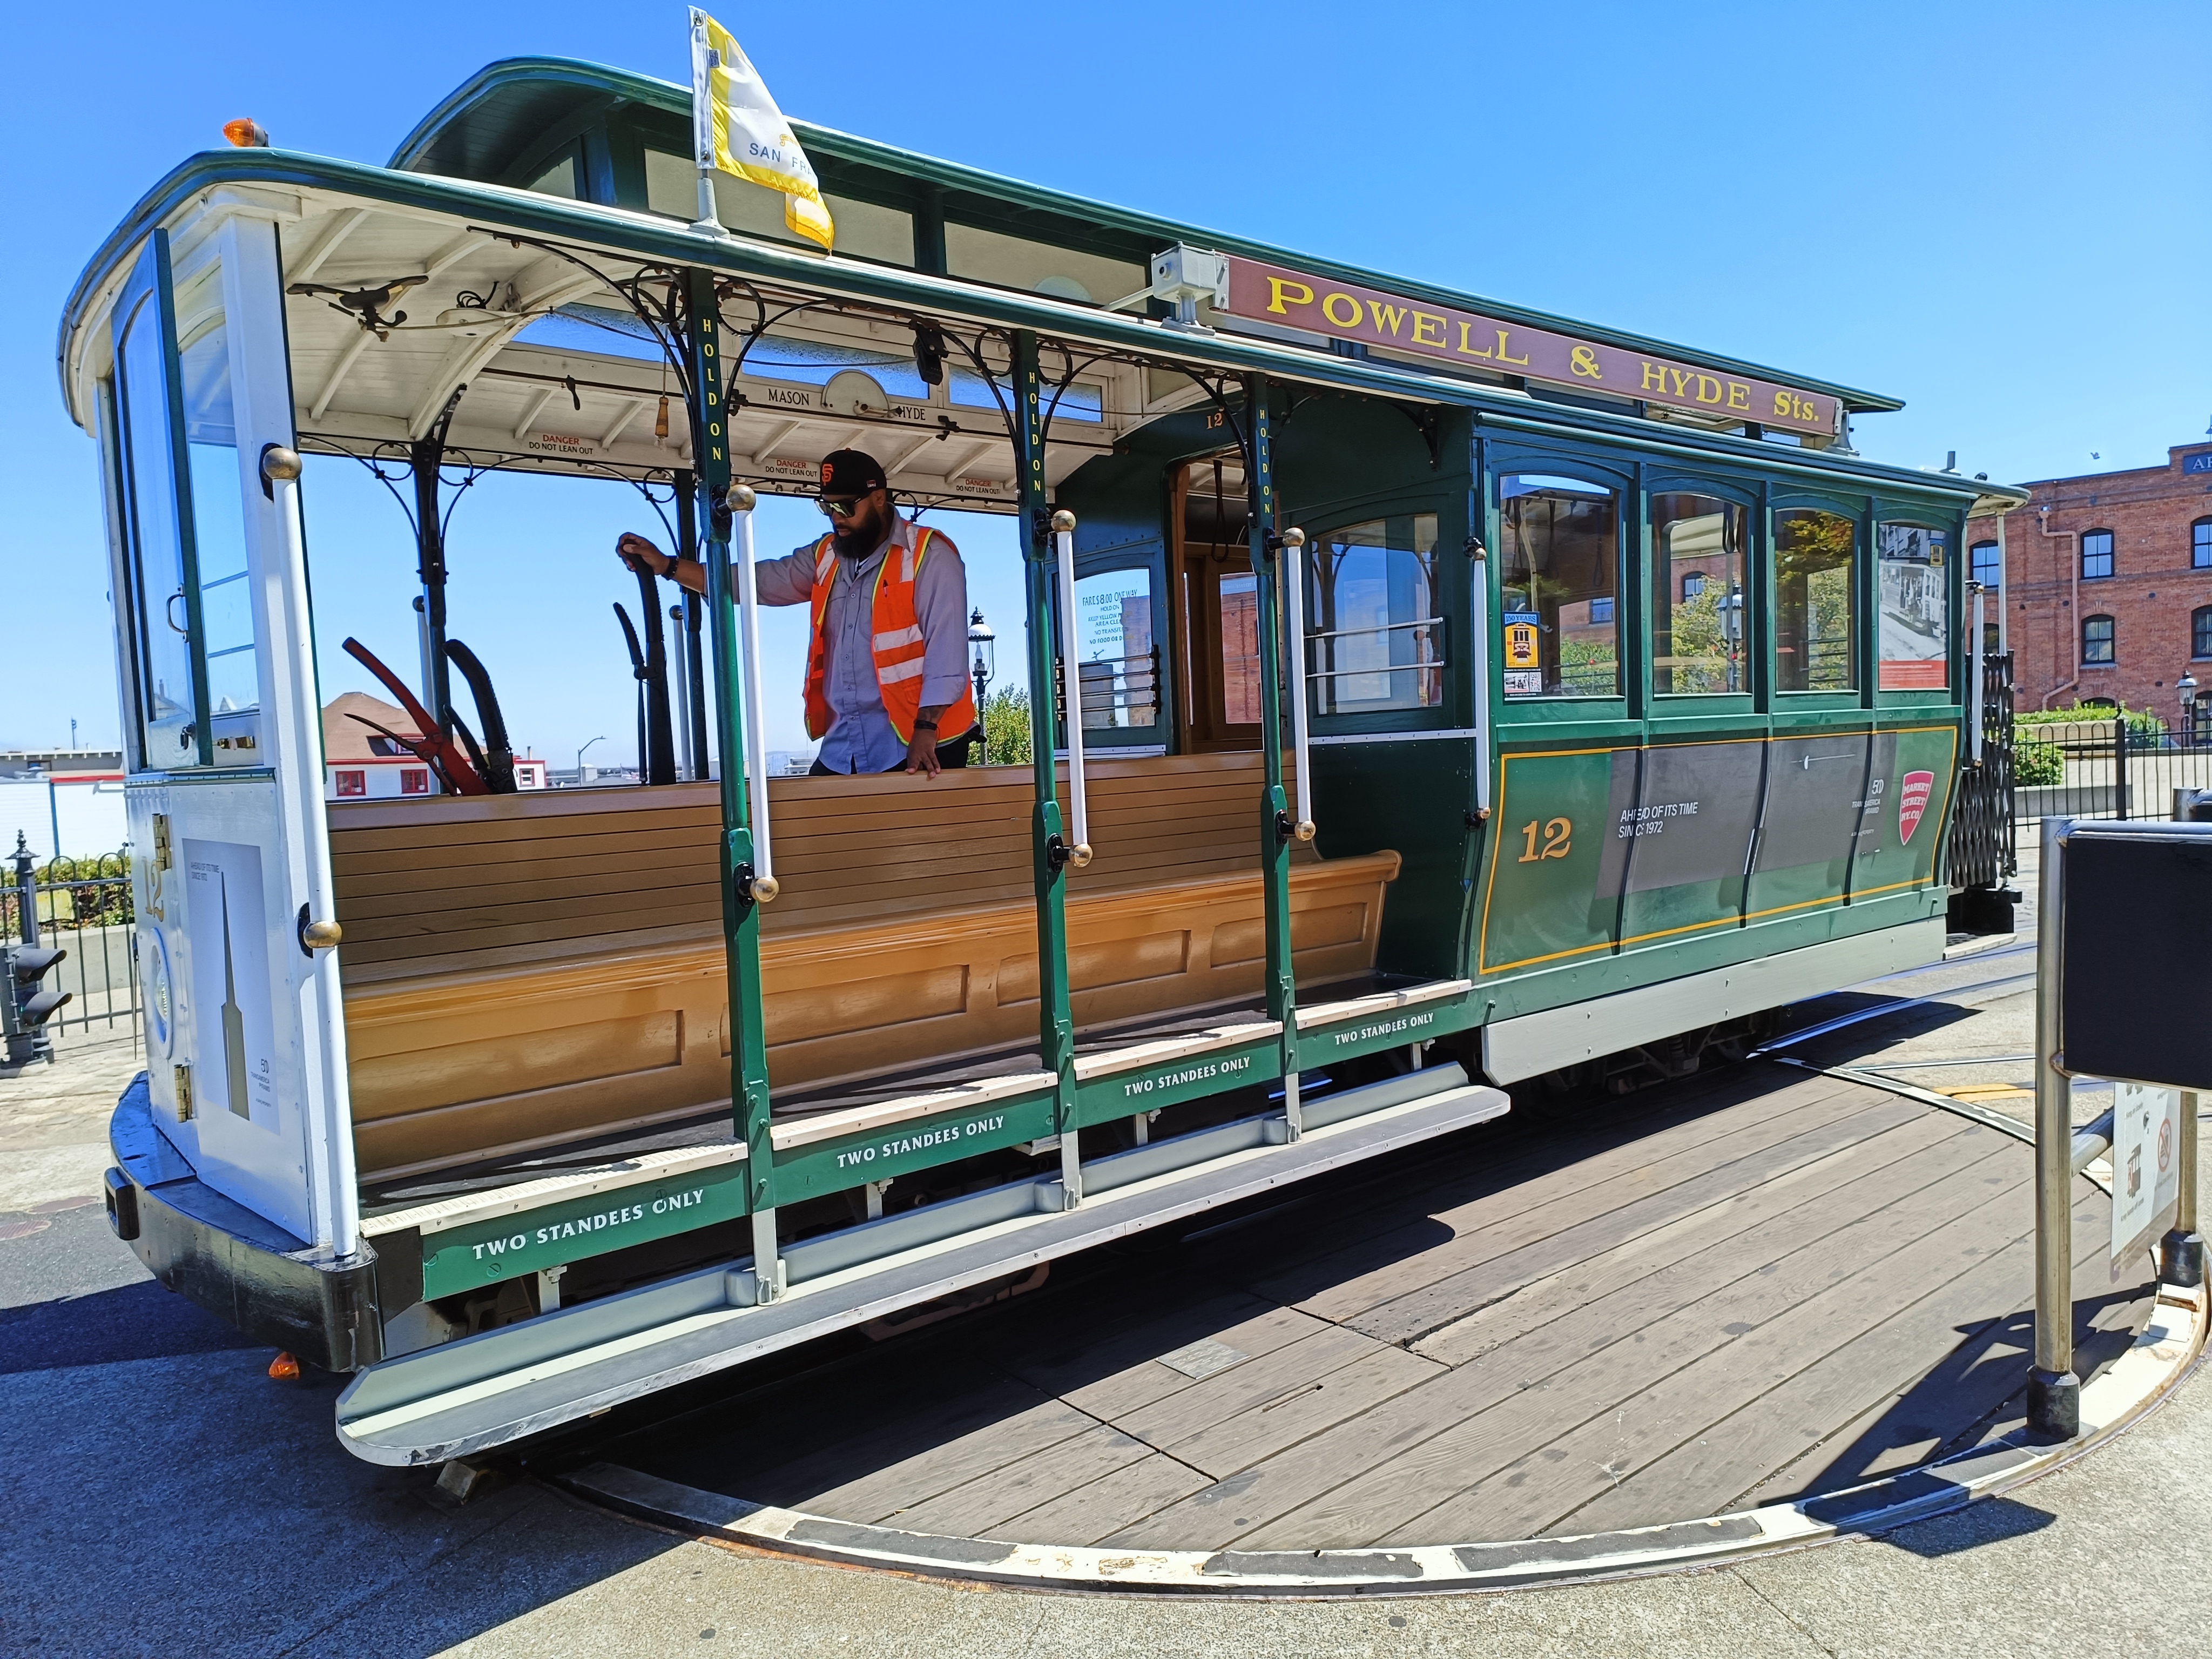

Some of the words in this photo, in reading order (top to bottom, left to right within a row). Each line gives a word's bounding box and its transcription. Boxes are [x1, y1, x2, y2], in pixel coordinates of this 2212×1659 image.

[749, 143, 780, 162] SAN
[1267, 276, 1528, 365] POWELL
[1570, 346, 1602, 380] &
[1641, 362, 1750, 410] HYDE
[1774, 391, 1819, 422] Sts.
[703, 319, 717, 405] HOLD
[710, 423, 721, 460] ON
[768, 388, 810, 406] MASON
[899, 406, 926, 420] HYDE
[1029, 372, 1039, 445] HOLD
[1206, 413, 1223, 429] 12
[542, 443, 556, 451] NOT
[543, 434, 579, 445] DANGER
[1260, 409, 1268, 473] HOLD
[777, 460, 806, 469] DANGER
[1033, 460, 1041, 491] ON
[1263, 485, 1270, 513] ON
[1872, 779, 1884, 794] 50
[1903, 783, 1930, 795] MARKET
[1620, 807, 1650, 822] AHEAD
[1651, 805, 1664, 818] OF
[1664, 804, 1677, 817] ITS
[1679, 801, 1698, 815] TIME
[1902, 796, 1926, 808] STREET
[1646, 821, 1663, 834] 1972
[1518, 817, 1572, 862] 12
[141, 856, 164, 922] 12
[1335, 1030, 1358, 1045] TWO
[1361, 1019, 1407, 1039] STANDEES
[1410, 1012, 1433, 1027] ONLY
[261, 1058, 269, 1074] 50
[1124, 1080, 1154, 1096] TWO
[1158, 1065, 1216, 1088] STANDEES
[1220, 1056, 1250, 1073] ONLY
[838, 1148, 875, 1168] TWO
[883, 1127, 959, 1157] STANDEES
[966, 1116, 1004, 1136] ONLY
[473, 1234, 526, 1259] TWO
[537, 1204, 643, 1244] STANDEES
[652, 1189, 704, 1214] ONLY
